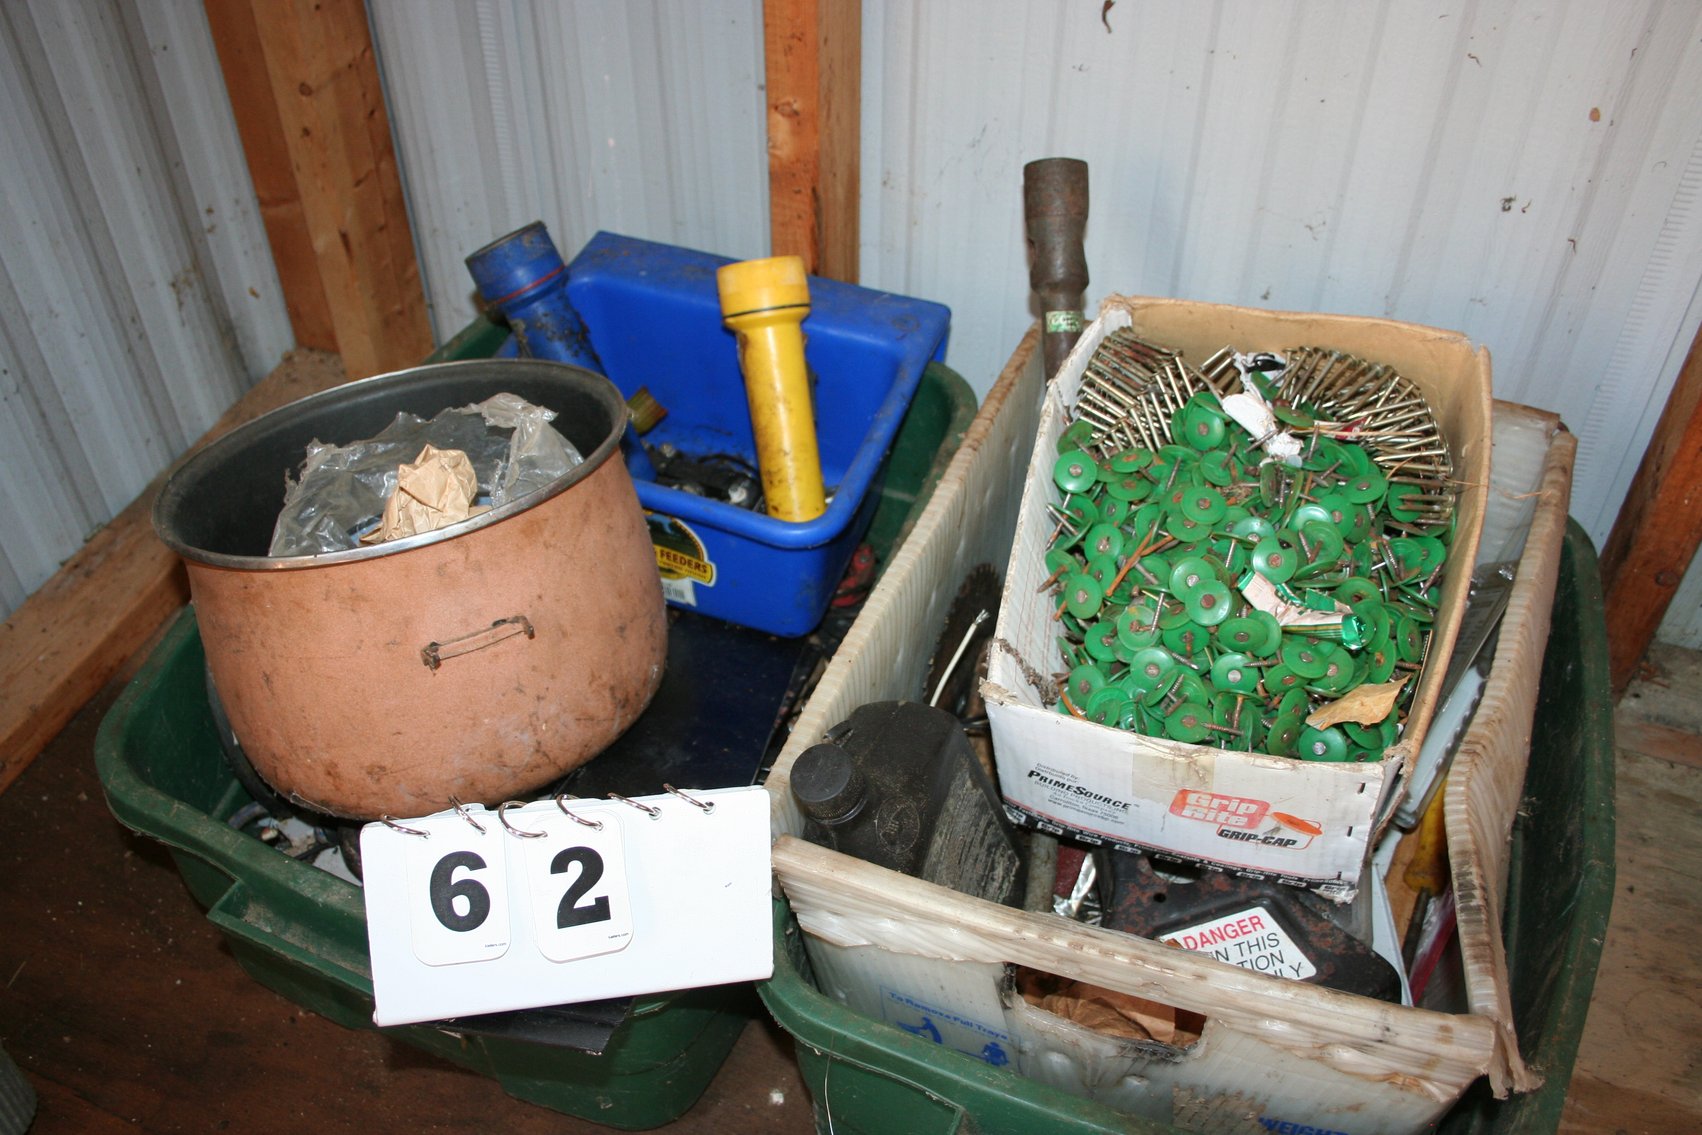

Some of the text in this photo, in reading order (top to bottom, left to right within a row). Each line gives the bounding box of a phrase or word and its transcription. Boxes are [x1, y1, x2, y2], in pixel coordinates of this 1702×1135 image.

[660, 549, 707, 574] FEEDERS
[1181, 805, 1248, 826] Rite
[1186, 793, 1258, 815] Grip
[1218, 828, 1297, 847] GRIP-CAP
[1183, 915, 1266, 951] DANGER
[1234, 932, 1280, 957] THIS
[889, 991, 903, 1002] To
[905, 998, 951, 1019] Remove
[975, 1023, 1008, 1040] Trays
